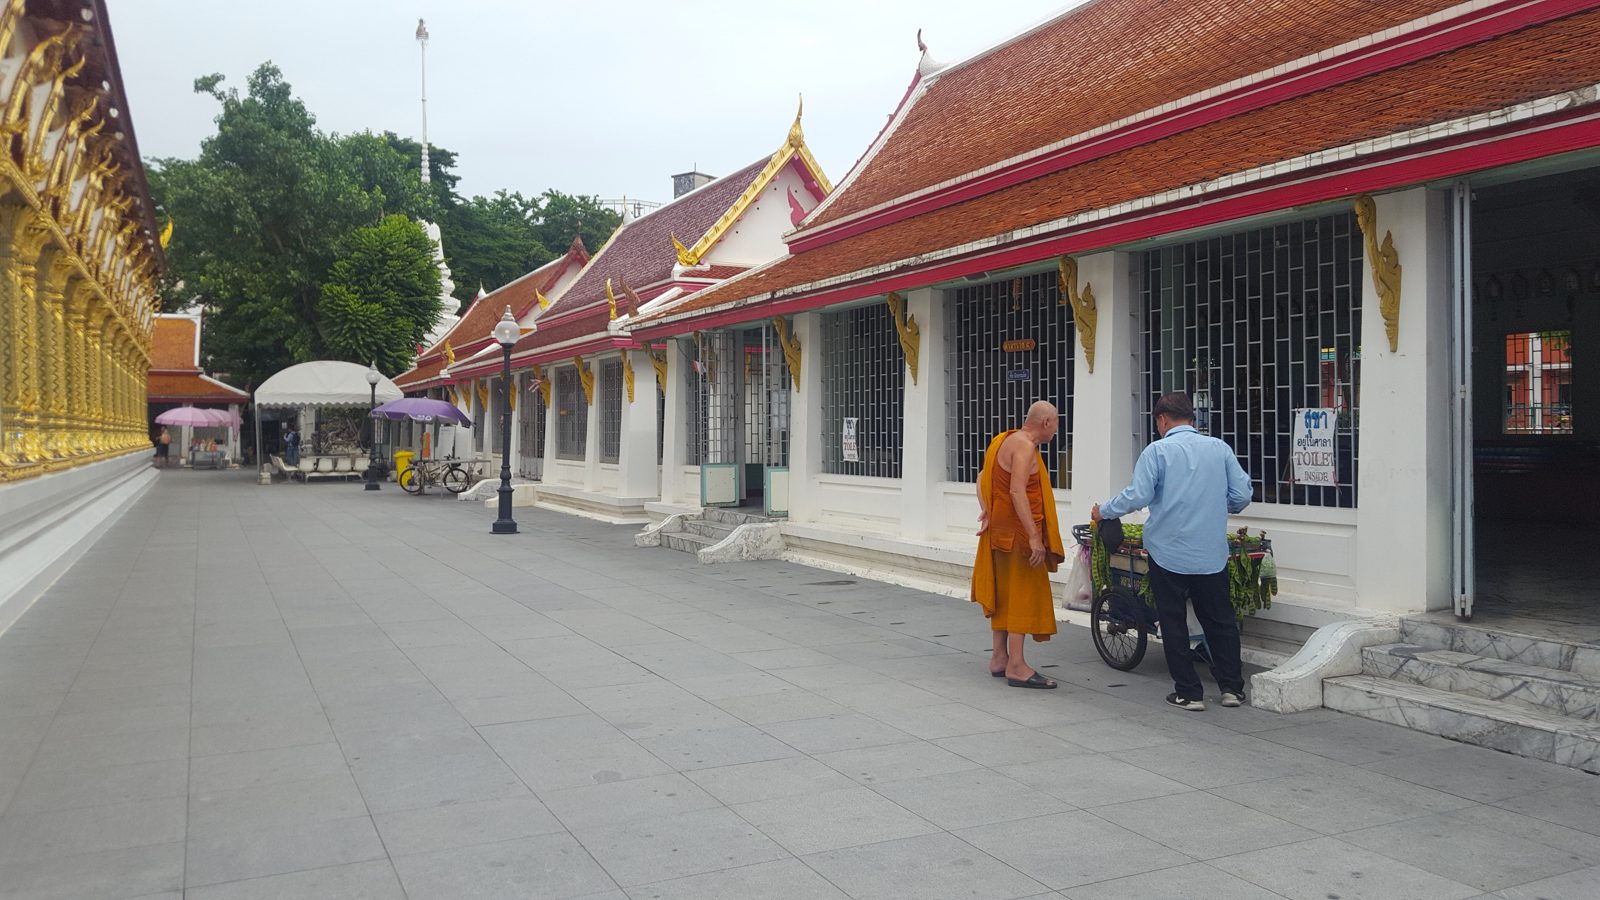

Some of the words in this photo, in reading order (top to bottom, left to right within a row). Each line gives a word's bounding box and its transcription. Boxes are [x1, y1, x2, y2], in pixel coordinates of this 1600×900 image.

[1304, 409, 1328, 438] สุขา
[1294, 452, 1335, 467] TOILET
[1304, 471, 1329, 482] INSIDE
